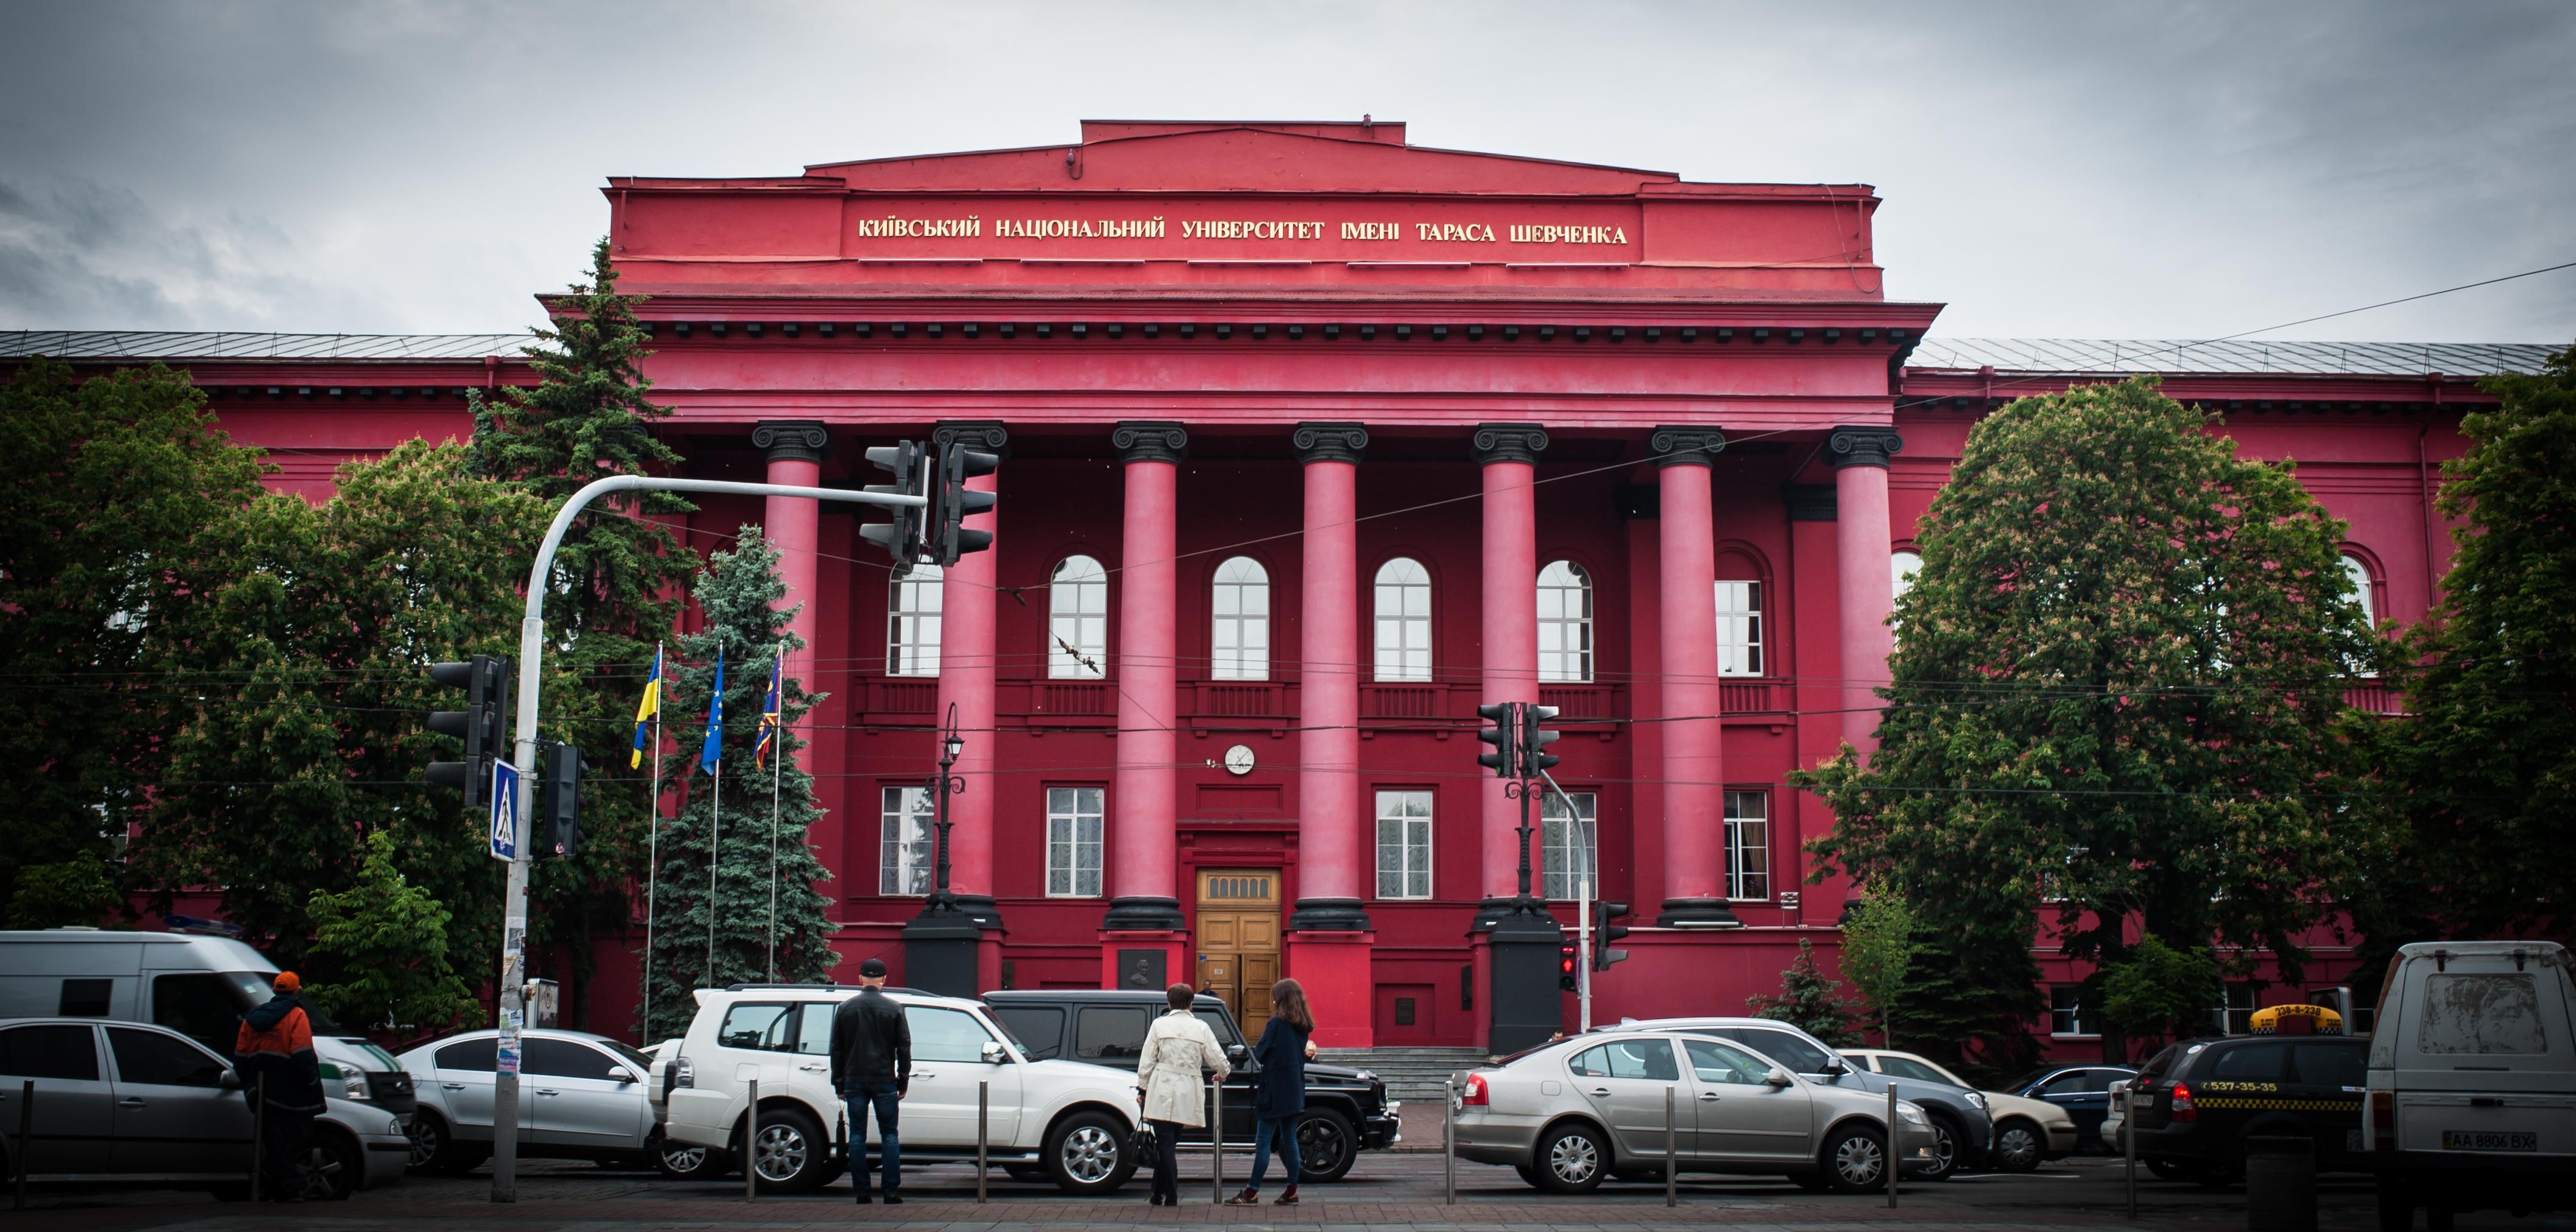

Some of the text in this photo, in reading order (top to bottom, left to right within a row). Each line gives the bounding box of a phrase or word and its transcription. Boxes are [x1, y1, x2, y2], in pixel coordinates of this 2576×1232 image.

[859, 215, 1628, 244] КИЇВСЬКИЙ НАЦІОНАЛЬНИЙ УНІВЕРСИТЕТ ІМЕНІ ТАРАСА ШЕВЧЕНКА
[2275, 1005, 2321, 1016] 238-8-238
[2211, 1081, 2277, 1092] 537-35-35
[2453, 1134, 2532, 1149] AA 8806 BX
